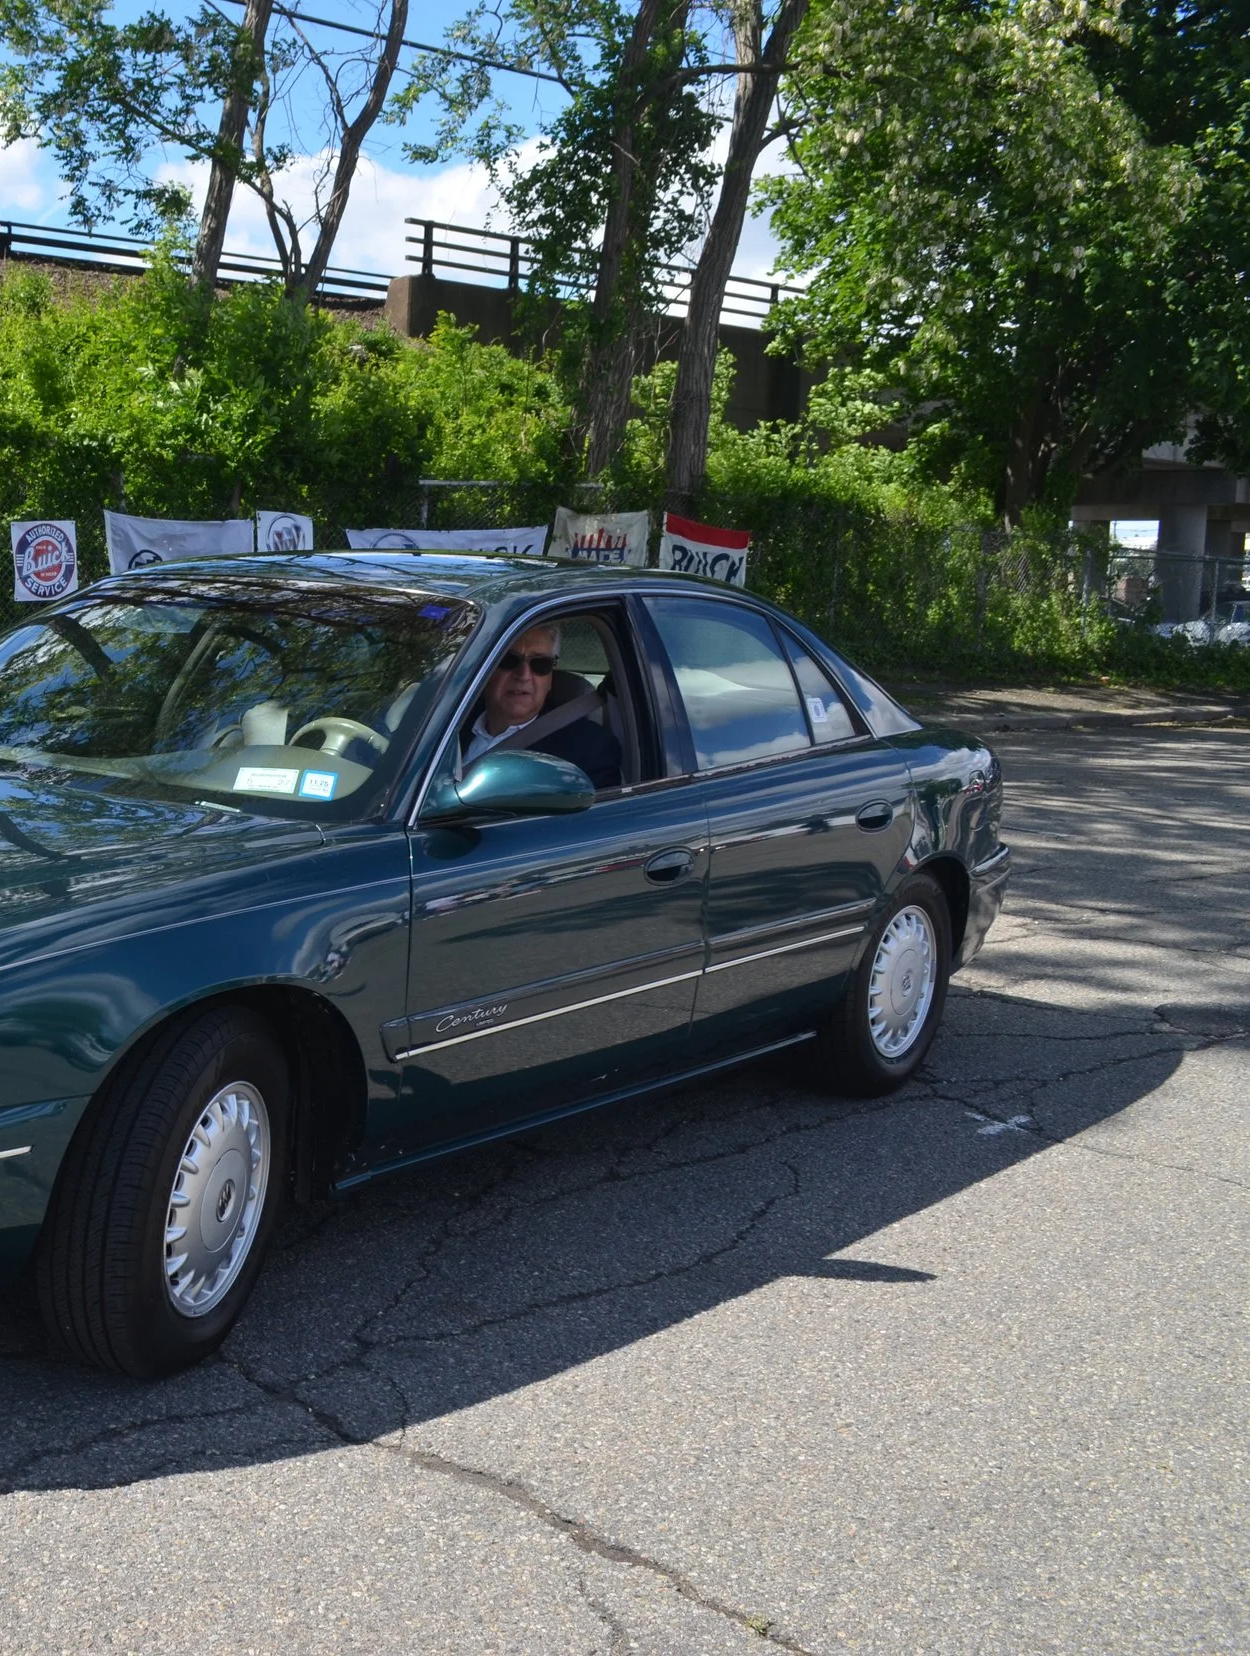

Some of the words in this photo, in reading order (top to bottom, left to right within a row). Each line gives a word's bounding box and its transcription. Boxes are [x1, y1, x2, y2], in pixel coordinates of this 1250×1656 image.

[25, 525, 64, 543] AUTHORIZED
[22, 541, 70, 577] Buick
[25, 577, 67, 596] SERVICE
[436, 1004, 507, 1032] Century
